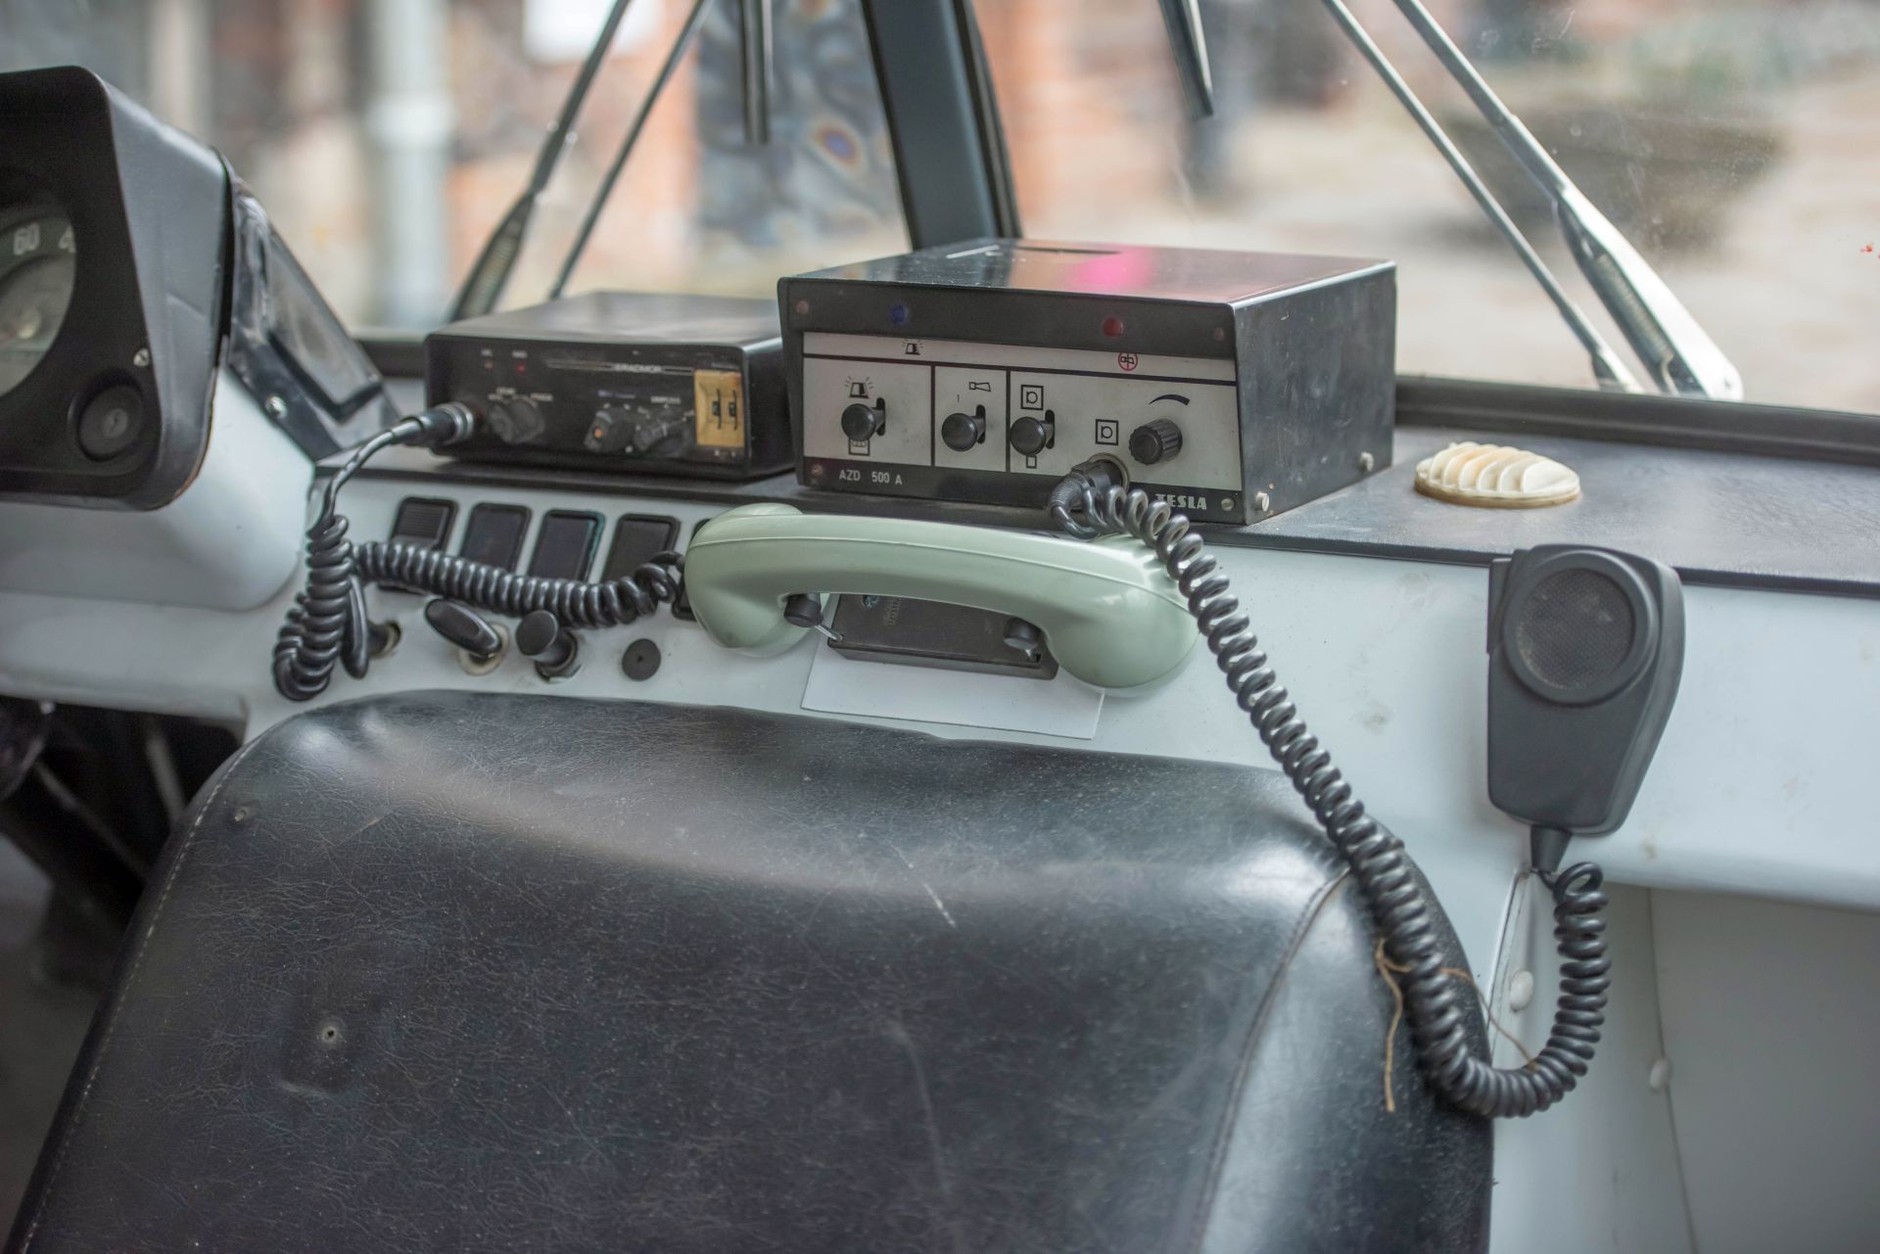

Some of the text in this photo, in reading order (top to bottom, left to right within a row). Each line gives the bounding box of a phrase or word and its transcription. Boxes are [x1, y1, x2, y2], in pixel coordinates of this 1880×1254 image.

[13, 222, 40, 256] 60
[839, 469, 903, 485] AZD 500 A
[1155, 493, 1207, 510] TESLA
